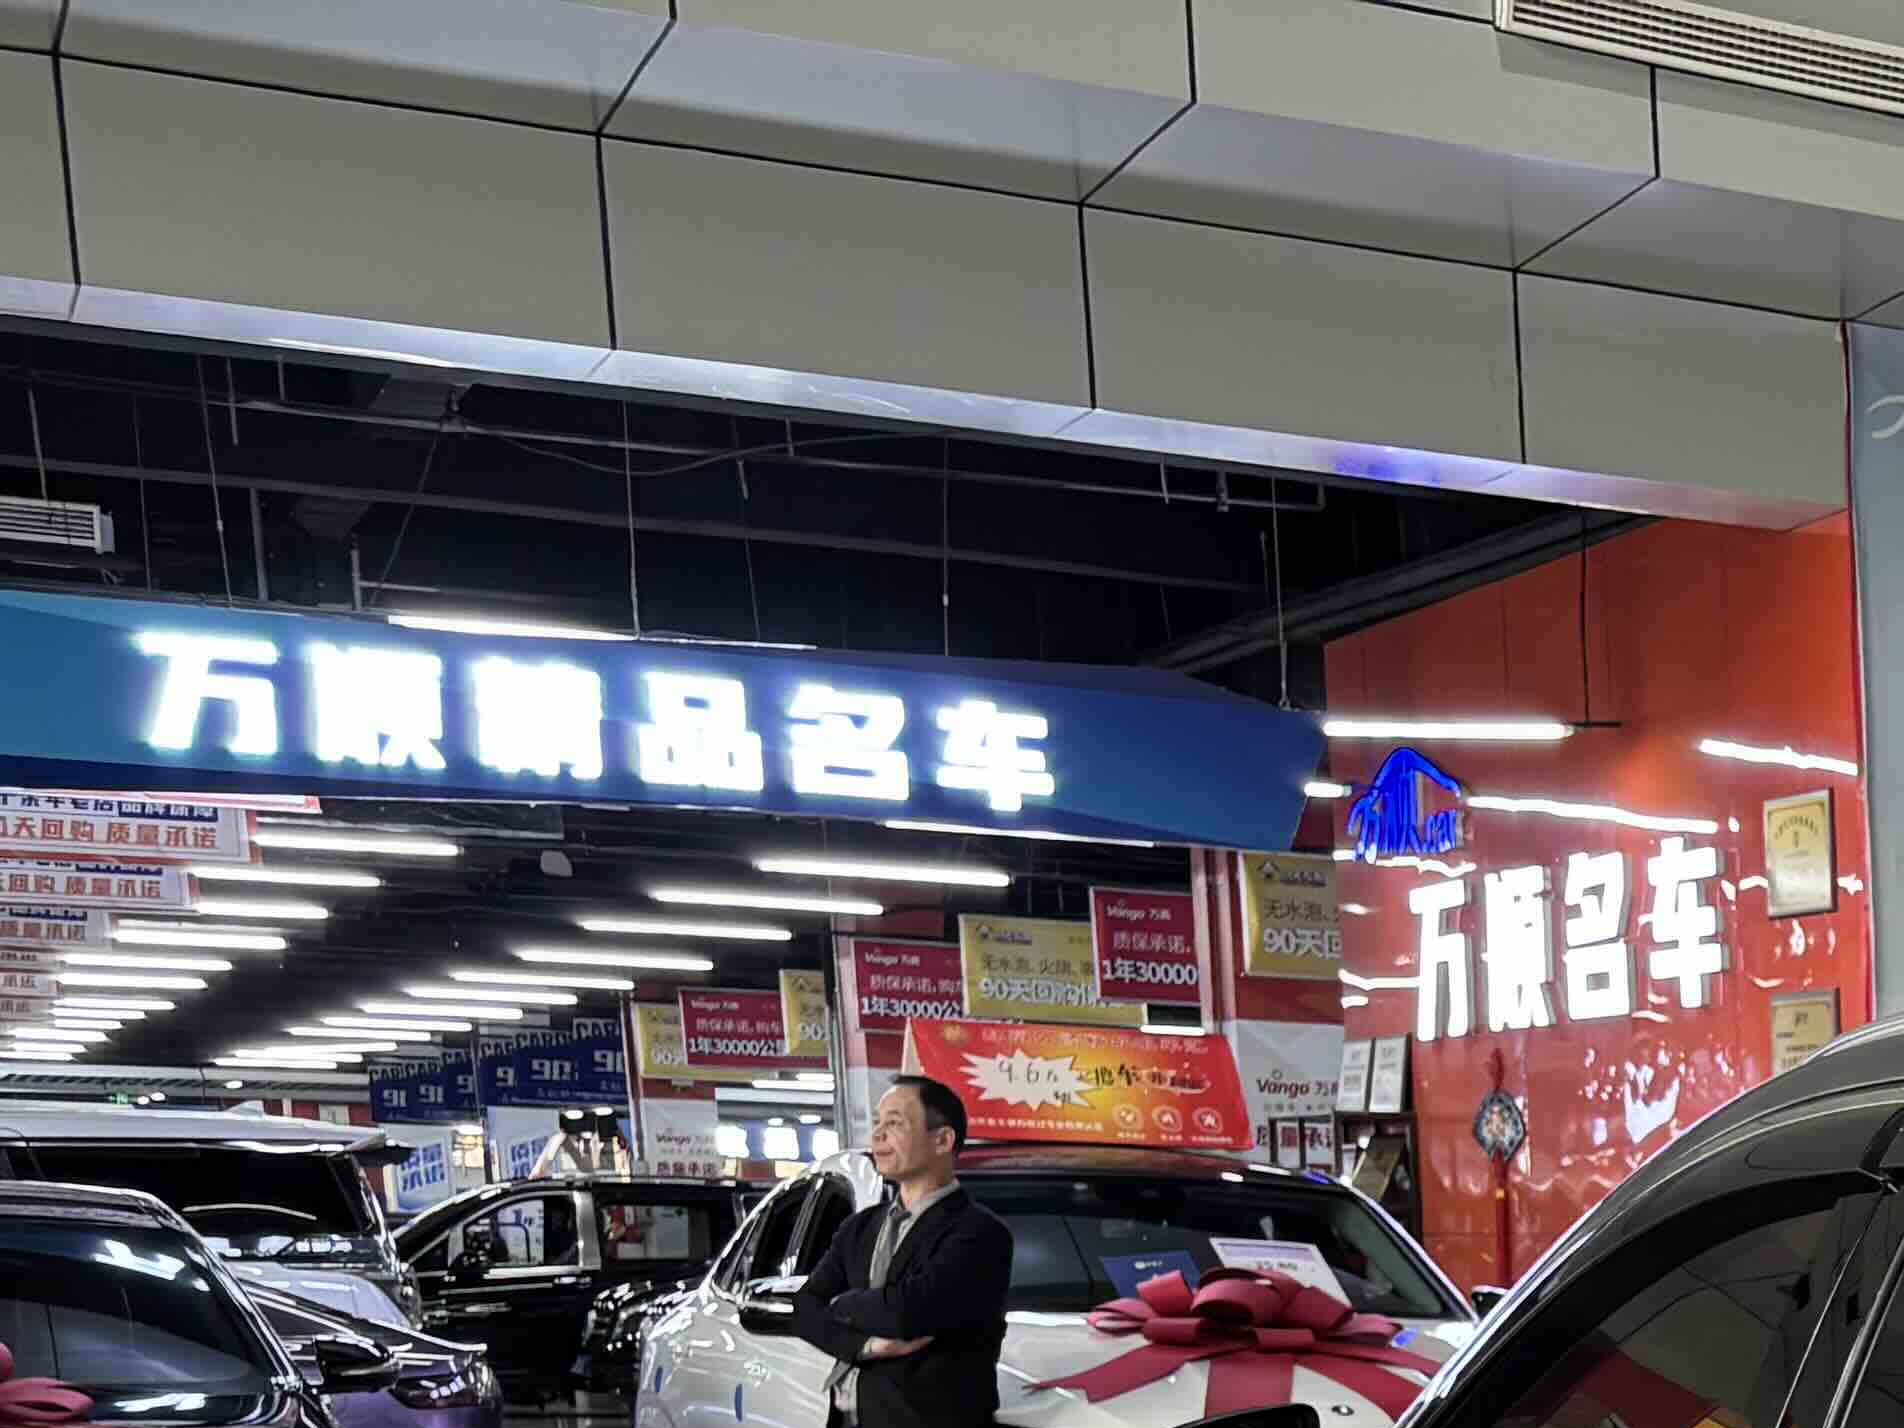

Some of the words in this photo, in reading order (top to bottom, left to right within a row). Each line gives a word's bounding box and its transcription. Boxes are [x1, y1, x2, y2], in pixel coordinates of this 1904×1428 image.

[106, 822, 218, 850] 质量承诺
[1408, 836, 1724, 1042] 万顺名车
[1256, 1078, 1311, 1098] Vango
